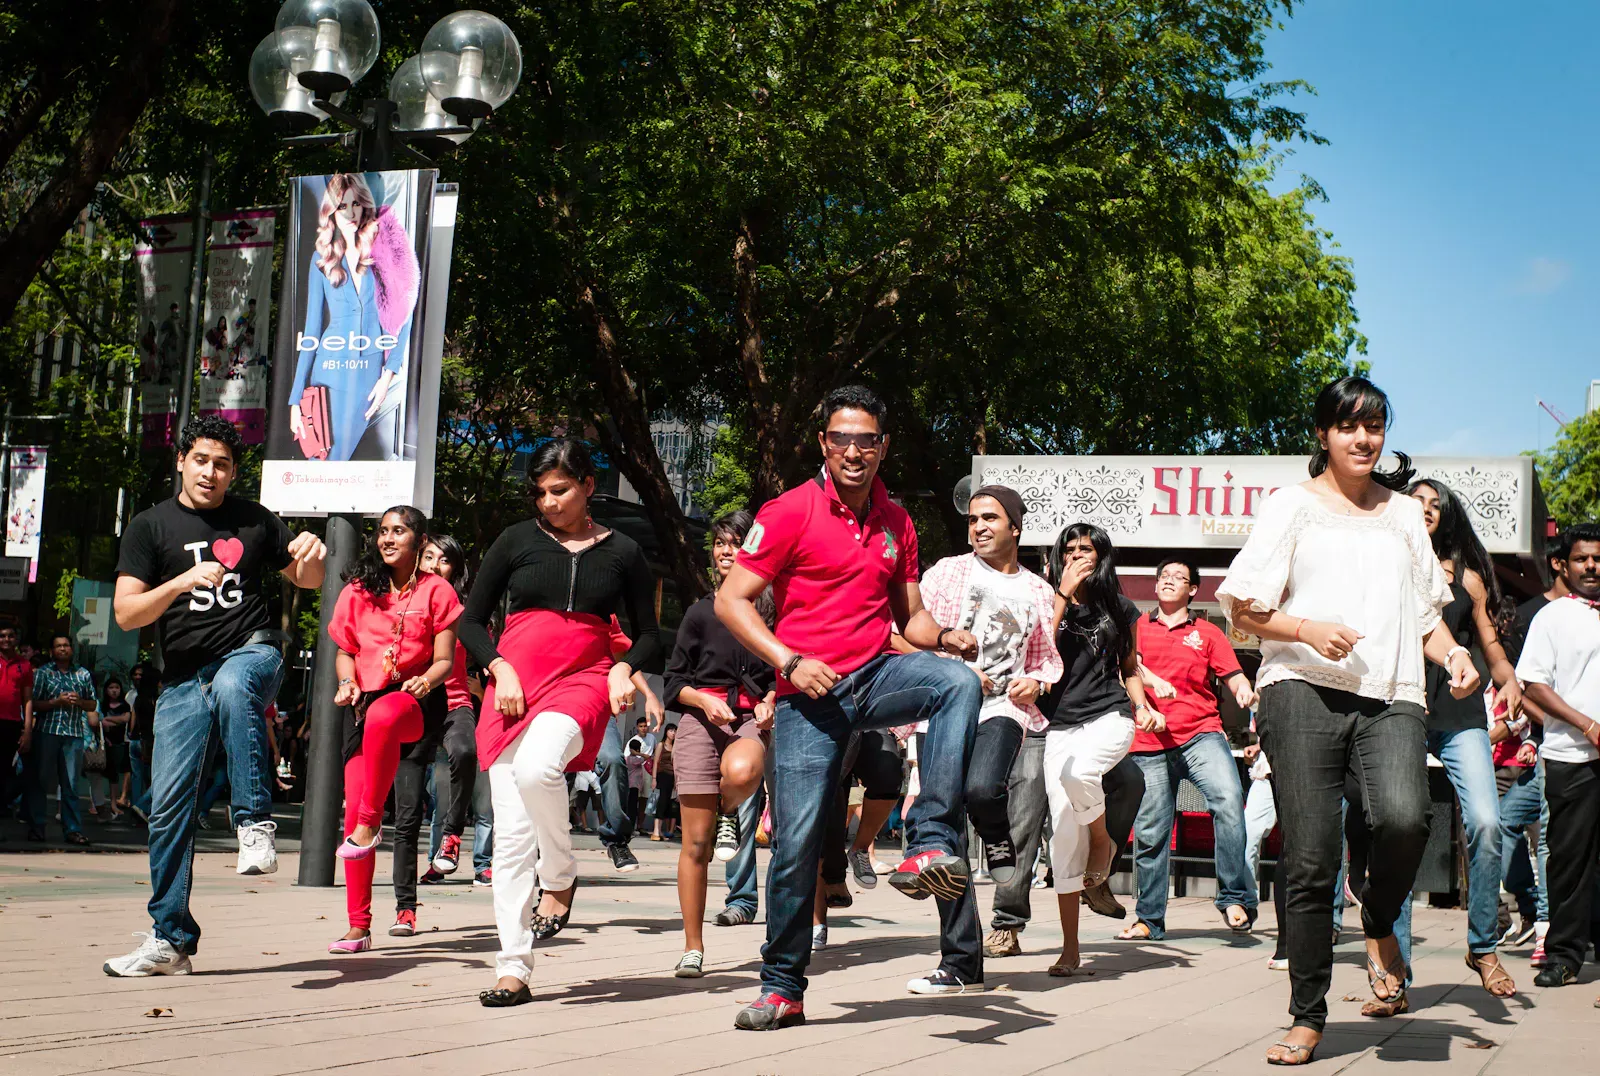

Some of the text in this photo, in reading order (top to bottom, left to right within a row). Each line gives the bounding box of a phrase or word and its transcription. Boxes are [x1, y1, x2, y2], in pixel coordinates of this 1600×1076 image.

[214, 256, 229, 265] The
[210, 300, 231, 310] 2012
[296, 331, 398, 351] bebe
[322, 360, 369, 370] #B1-10/11
[295, 474, 349, 486] Takashimaya
[1150, 467, 1281, 517] Shir
[189, 573, 243, 612] SG
